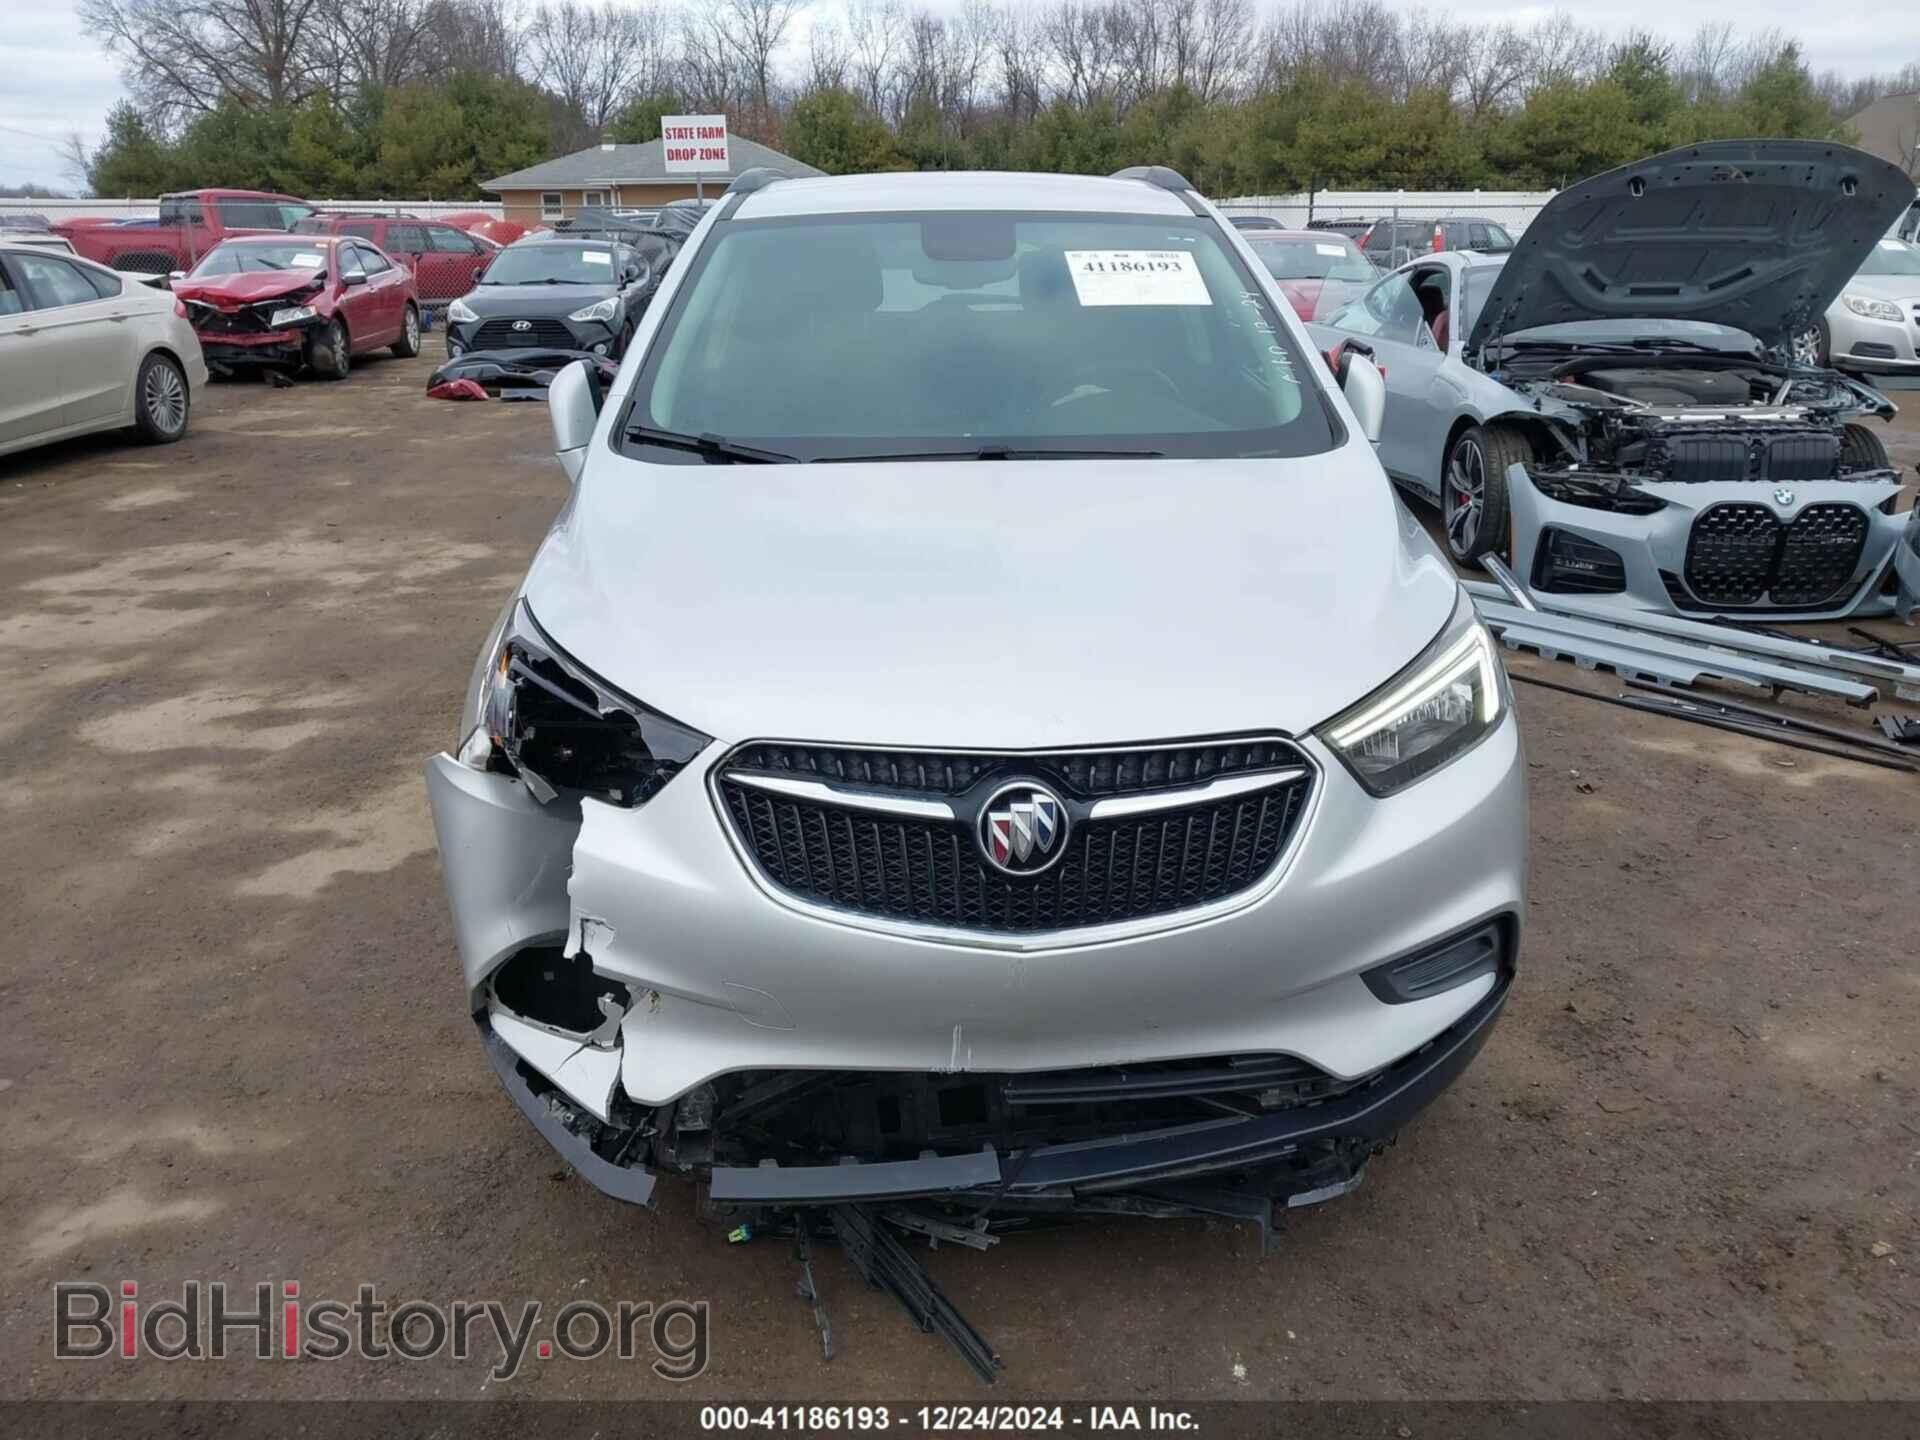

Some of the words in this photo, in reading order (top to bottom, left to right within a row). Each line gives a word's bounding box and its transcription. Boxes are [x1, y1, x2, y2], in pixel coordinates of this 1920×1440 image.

[664, 127, 695, 140] STATE
[697, 126, 724, 139] FARM
[667, 148, 697, 161] DROP
[699, 147, 726, 160] ZONE
[1083, 261, 1182, 273] 41186193
